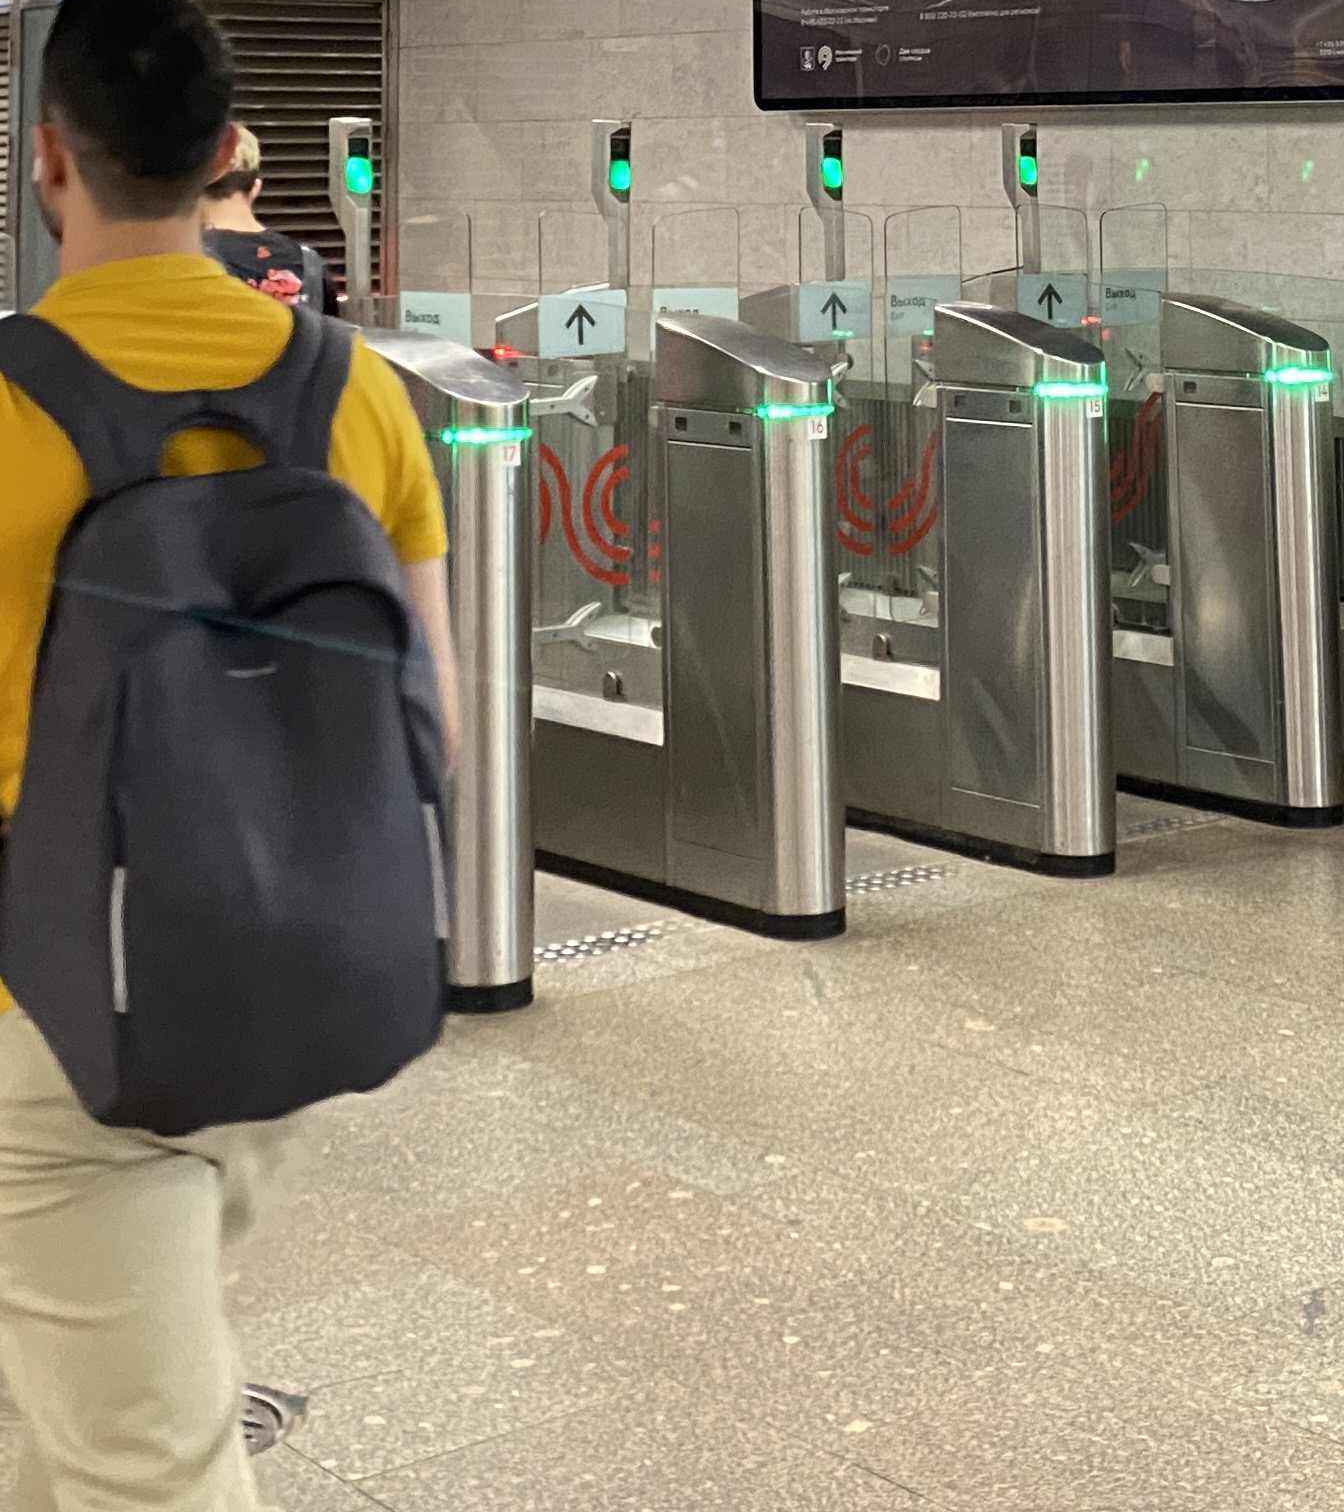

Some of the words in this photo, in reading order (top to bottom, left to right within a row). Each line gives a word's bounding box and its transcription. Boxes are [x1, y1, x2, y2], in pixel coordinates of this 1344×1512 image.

[890, 294, 926, 308] Выход
[405, 309, 440, 325] Выход
[1090, 399, 1101, 414] 15
[810, 419, 824, 434] 16
[503, 445, 517, 463] 17
